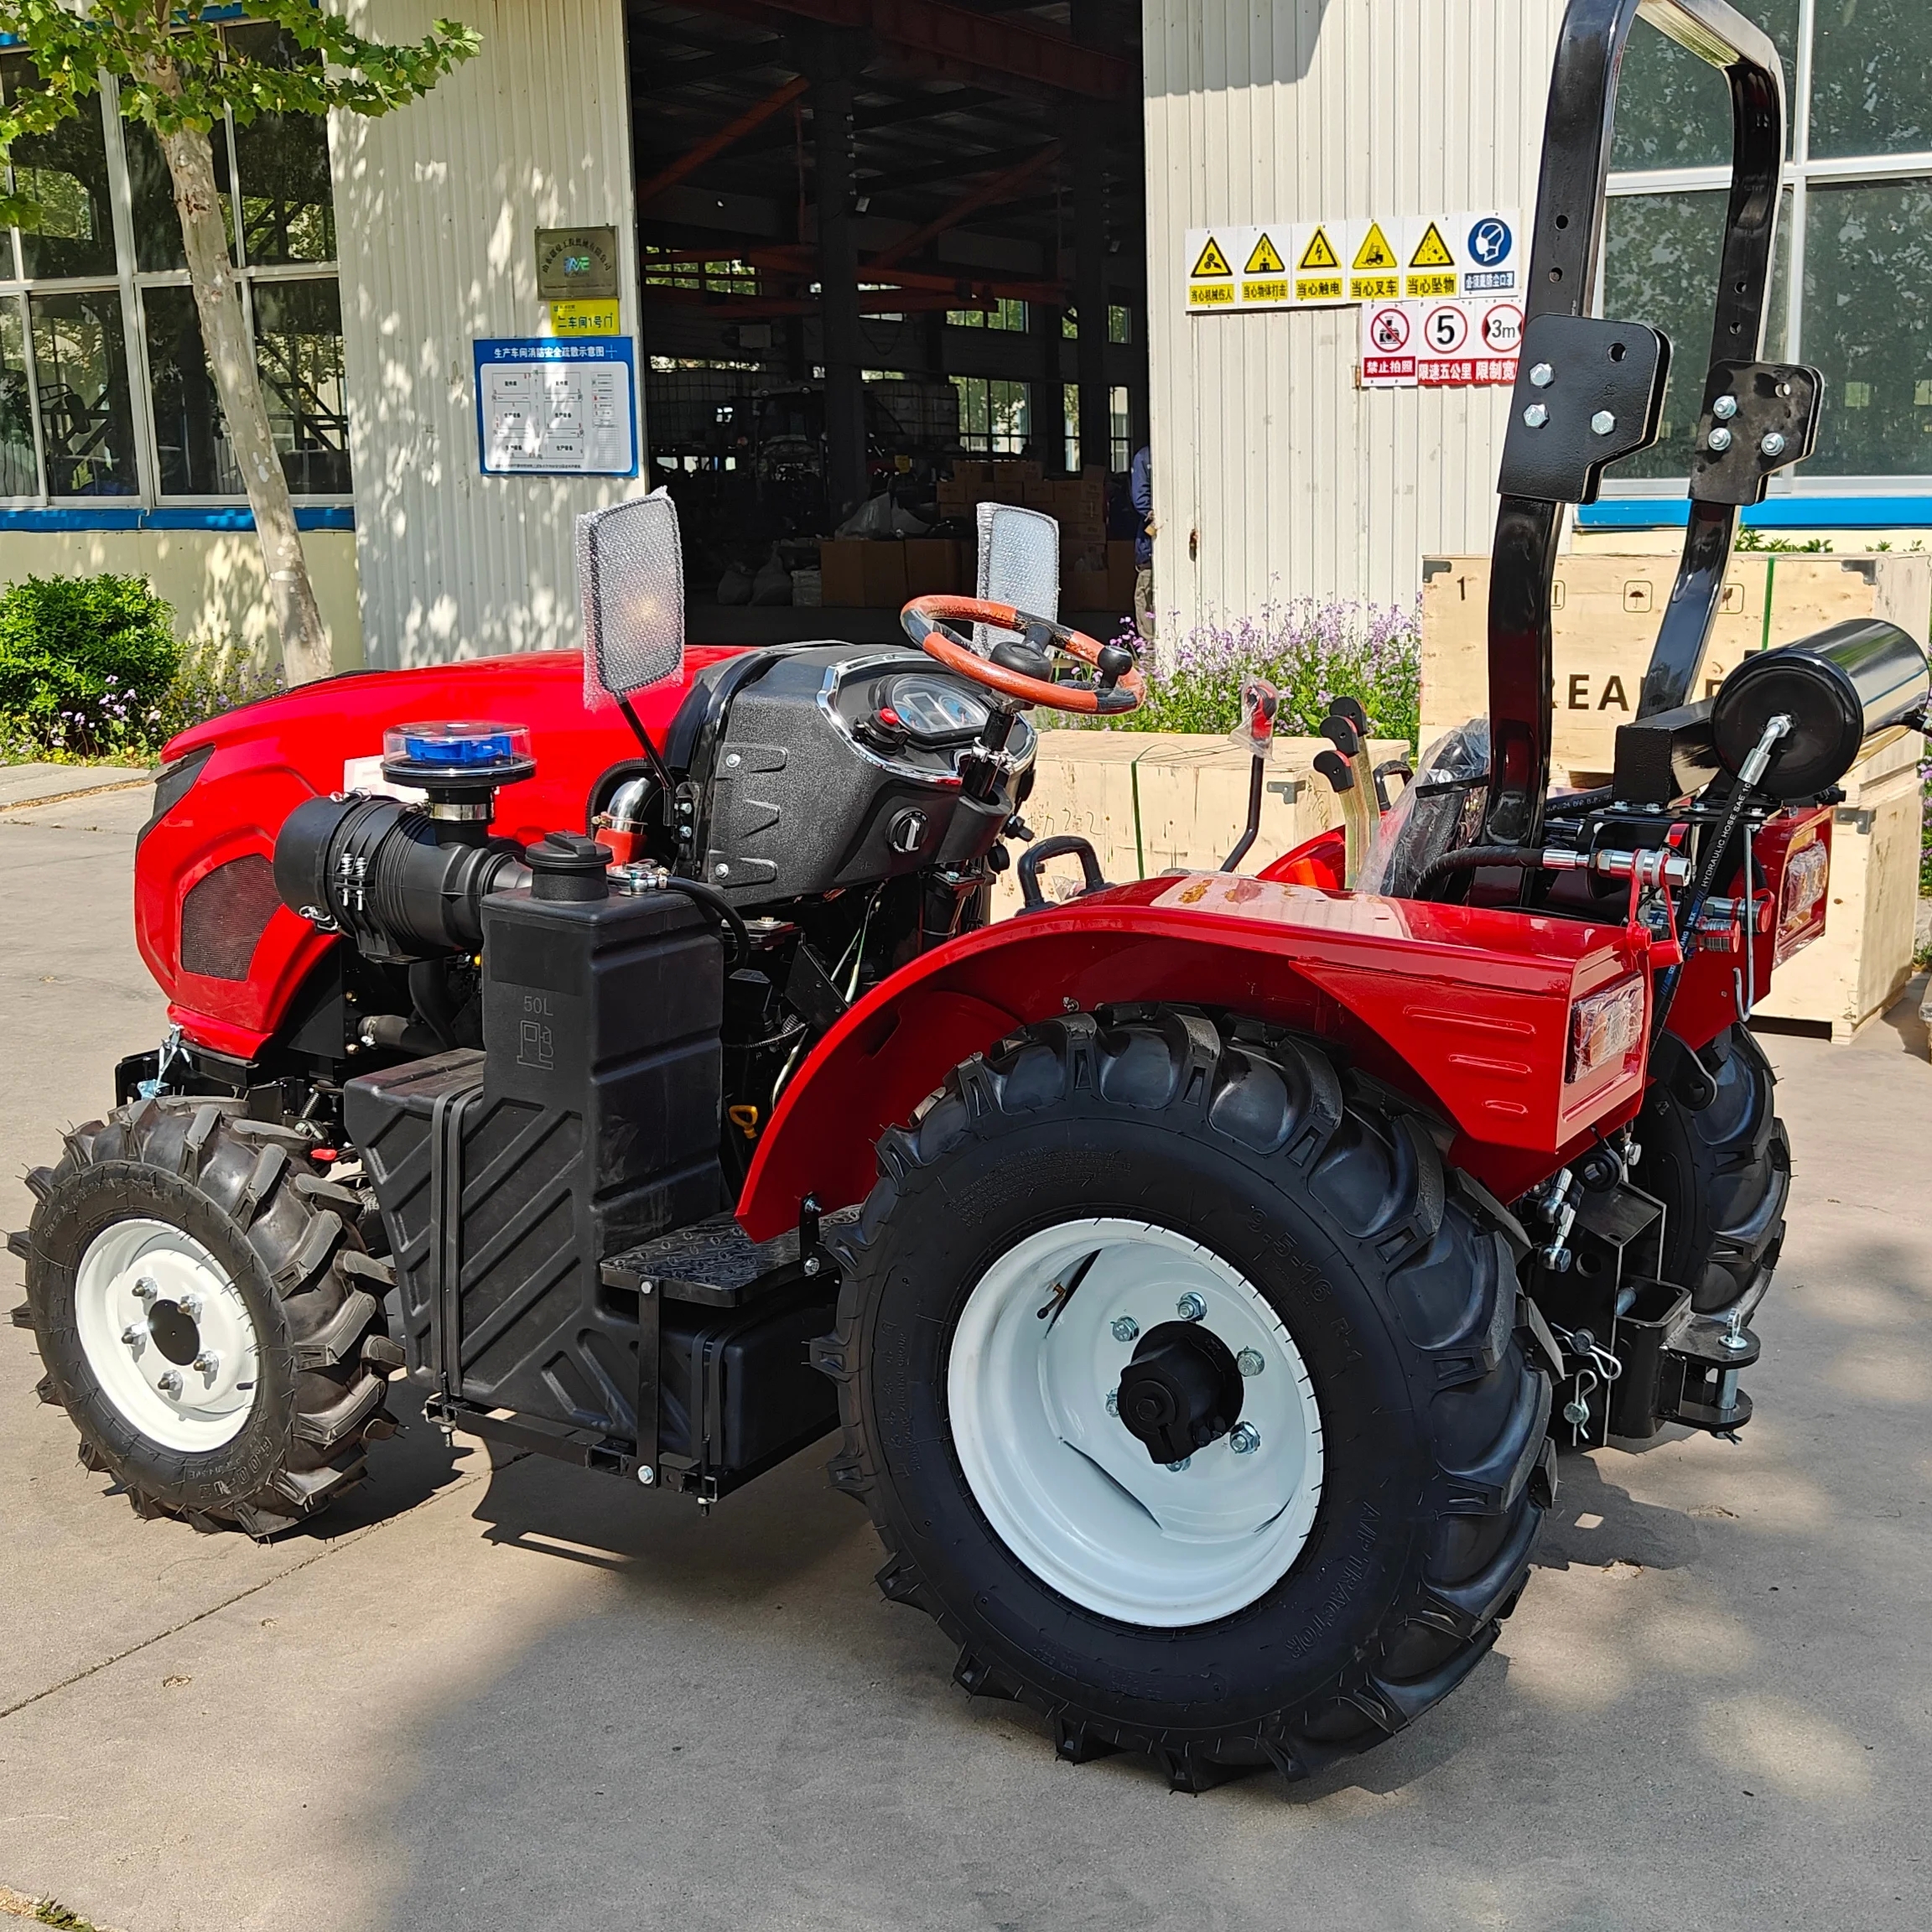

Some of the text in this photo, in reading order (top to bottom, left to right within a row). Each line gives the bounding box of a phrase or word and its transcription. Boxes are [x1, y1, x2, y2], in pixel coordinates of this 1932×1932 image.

[1244, 285, 1287, 299] 当心物体打击
[1297, 282, 1341, 297] 当心触电
[1352, 279, 1397, 297] 当心叉车
[1408, 277, 1455, 294] 当心坠物
[1192, 290, 1233, 303] 当心机械伤人
[1436, 314, 1455, 345] 5
[1492, 319, 1515, 339] 3m
[494, 346, 605, 358] 生产车间消防安全疏散示意图
[1367, 360, 1413, 374] 禁止拍照
[1418, 363, 1472, 381] 限速五公里
[1476, 361, 1516, 380] 限制宽
[1457, 576, 1466, 601] 1
[1701, 839, 1725, 887] HYDRAULIC
[1722, 813, 1737, 839] HOSE
[1733, 794, 1745, 813] SAE
[523, 995, 553, 1015] 50L
[1246, 1208, 1333, 1302] 9.5-16
[1331, 1317, 1363, 1362] R-1
[1285, 1555, 1369, 1659] TRACTOR
